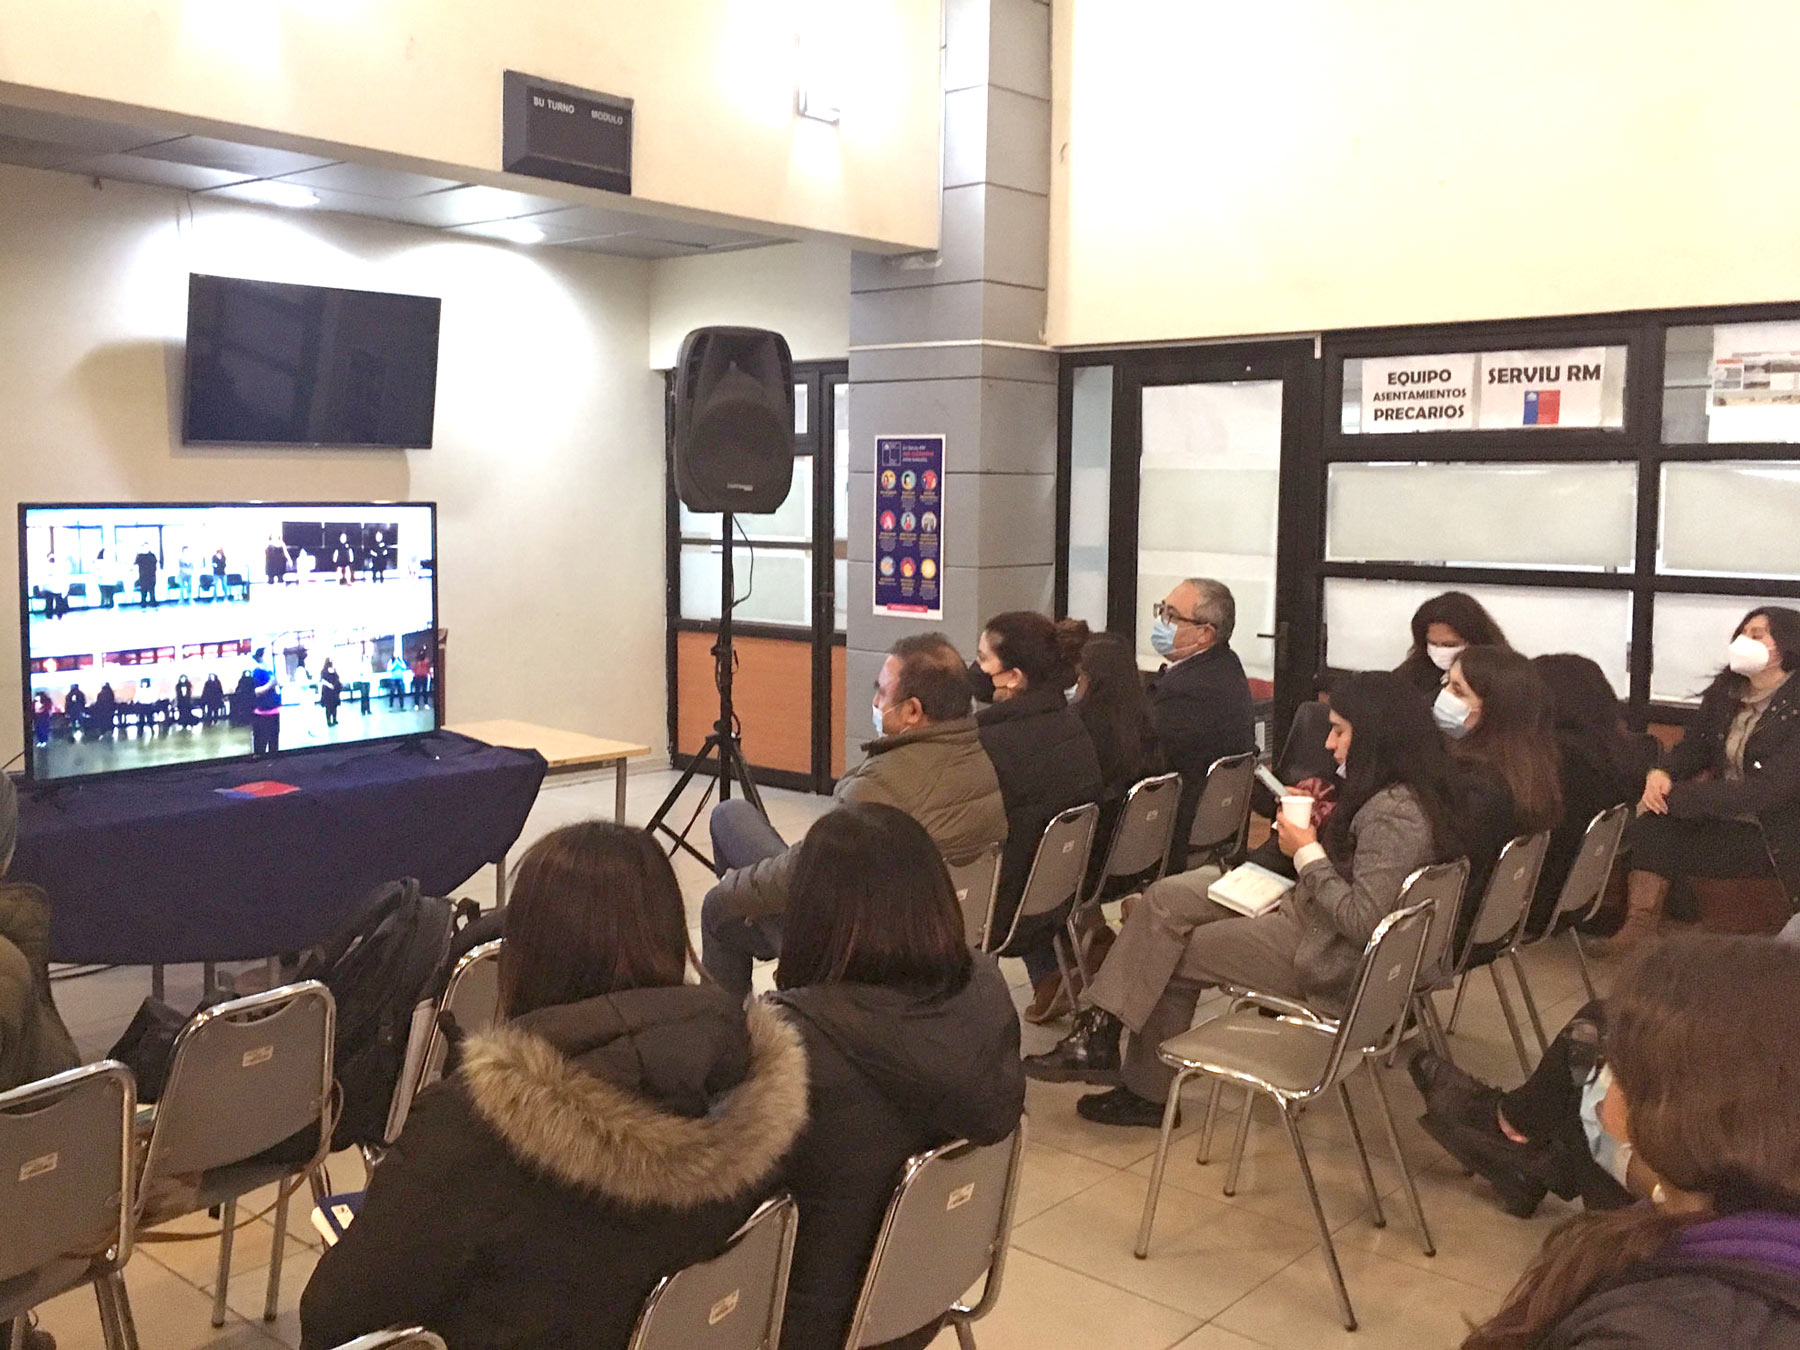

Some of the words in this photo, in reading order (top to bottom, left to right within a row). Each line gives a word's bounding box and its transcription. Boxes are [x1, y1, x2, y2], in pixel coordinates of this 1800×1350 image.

[547, 98, 575, 114] TURNO
[591, 109, 624, 125] MODULO
[1387, 369, 1452, 386] EQUIPO
[1488, 366, 1560, 384] SERVIU
[1567, 363, 1601, 382] RM
[1373, 388, 1467, 402] ASENTAMIENTOS
[1374, 405, 1465, 421] PRECARIOS
